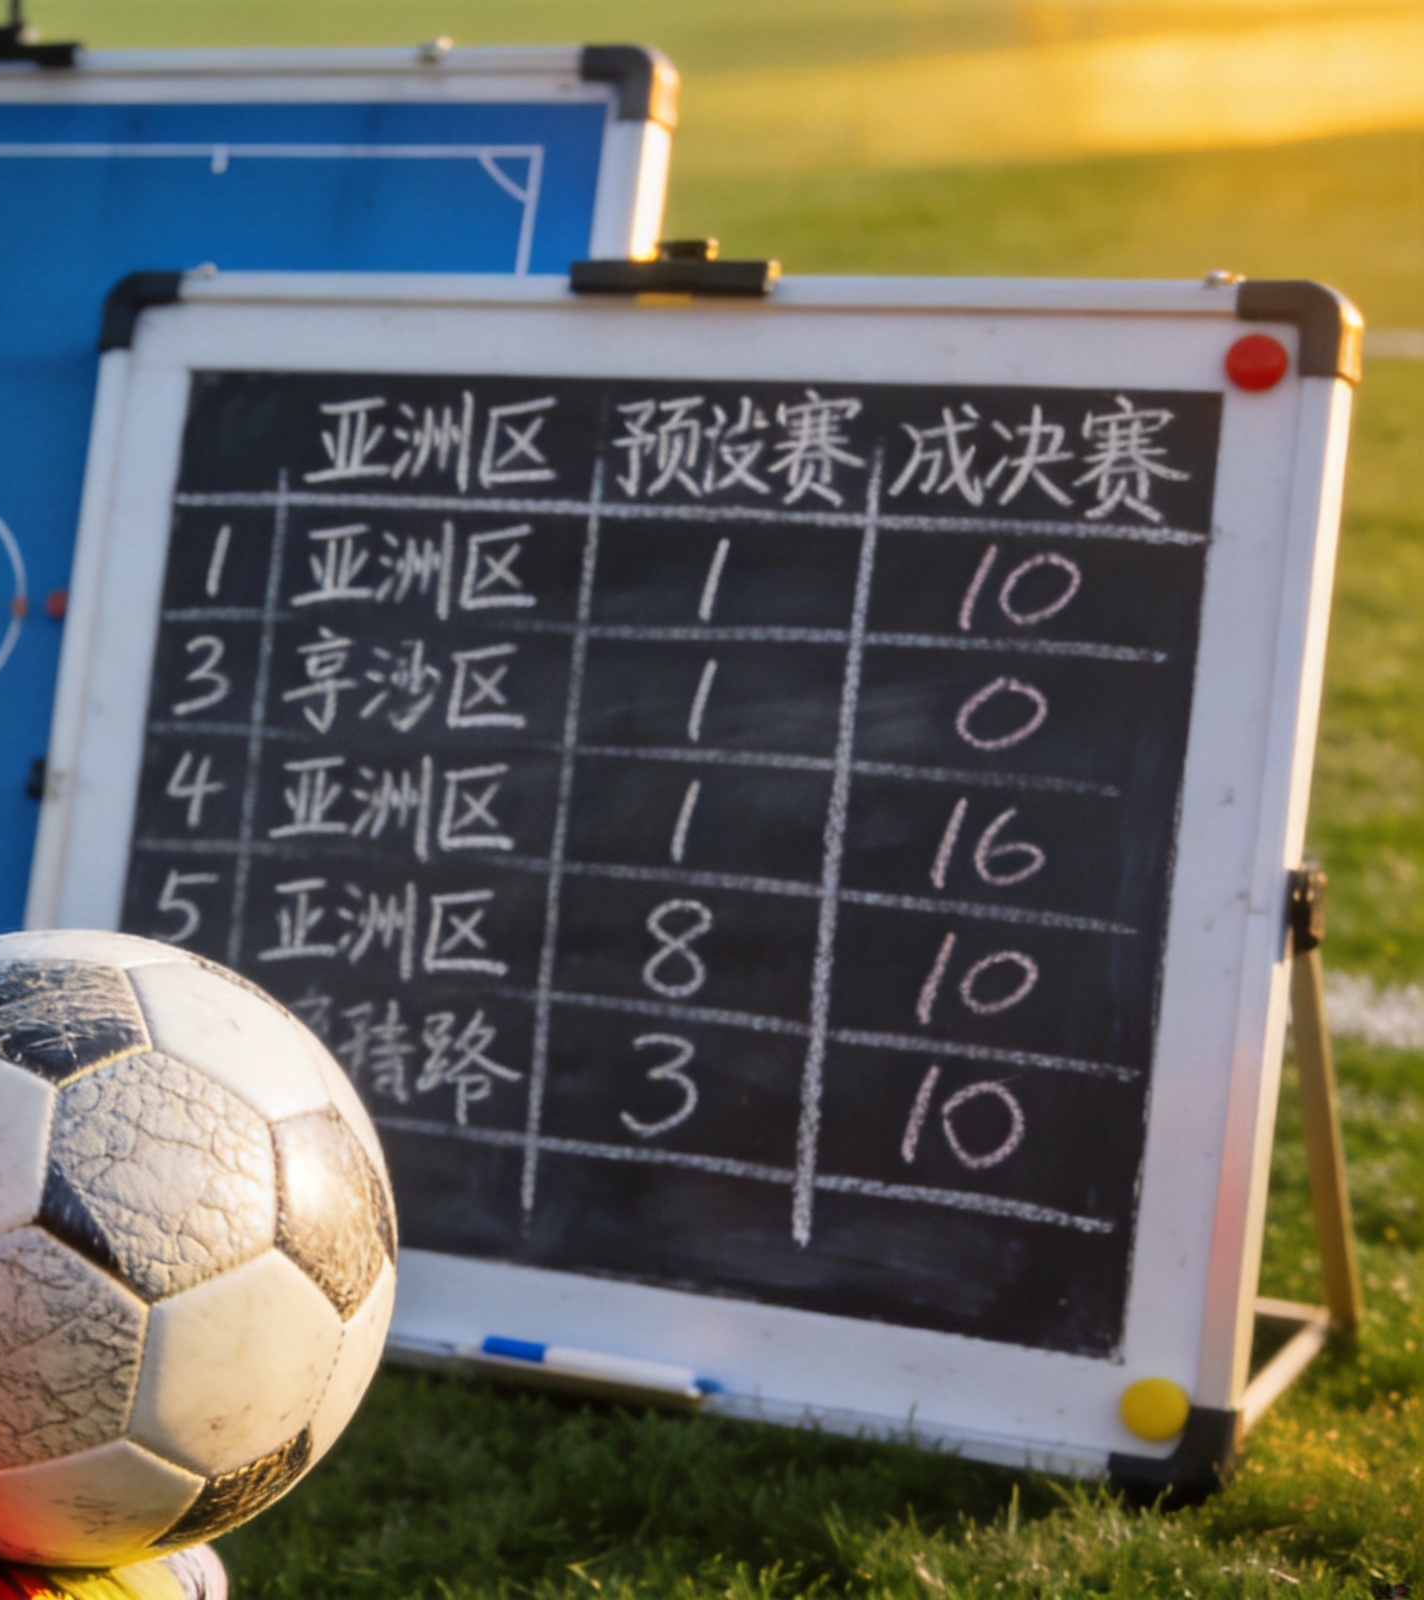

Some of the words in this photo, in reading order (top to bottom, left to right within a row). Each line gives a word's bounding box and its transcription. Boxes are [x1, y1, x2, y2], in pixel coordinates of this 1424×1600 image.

[303, 390, 557, 493] 亚洲区
[888, 394, 1191, 523] 成决赛
[205, 524, 232, 597] 1
[291, 520, 536, 620] 亚洲区
[699, 537, 730, 622] 1
[958, 543, 1081, 631] 10
[171, 634, 231, 716] 3
[688, 657, 717, 742] 1
[955, 676, 1048, 750] 0
[166, 751, 226, 828] 4
[269, 754, 516, 863] 亚洲区
[670, 780, 701, 862] 1
[930, 797, 1046, 890] 16
[156, 868, 220, 943] 5
[257, 880, 508, 982] 亚洲区
[642, 898, 713, 998] 8
[915, 932, 1039, 1025] 10
[620, 1032, 699, 1138] 3
[900, 1064, 1025, 1169] 10
